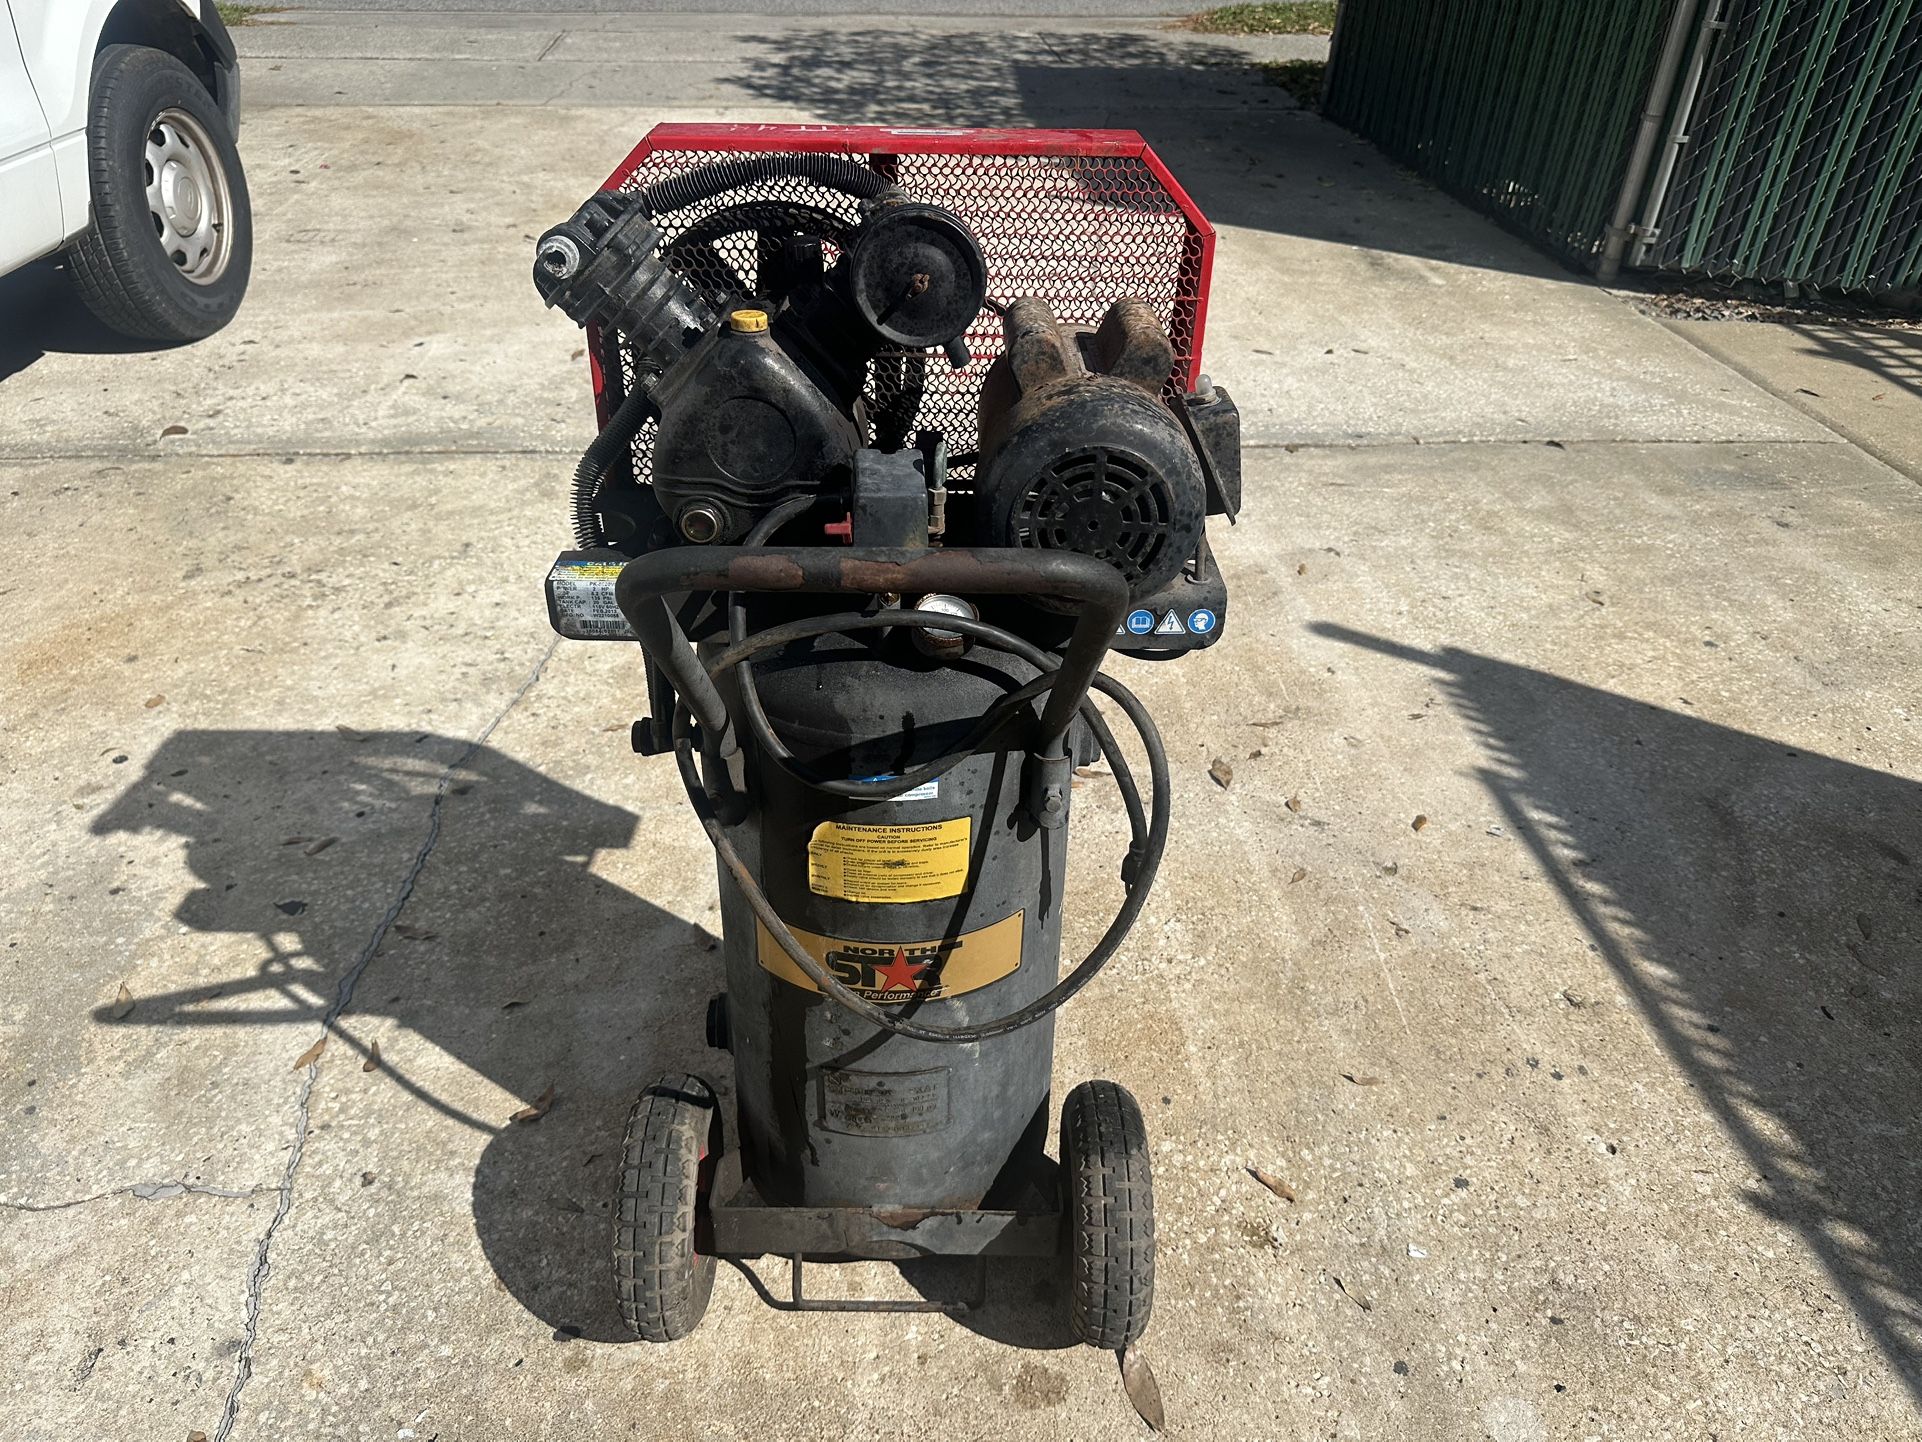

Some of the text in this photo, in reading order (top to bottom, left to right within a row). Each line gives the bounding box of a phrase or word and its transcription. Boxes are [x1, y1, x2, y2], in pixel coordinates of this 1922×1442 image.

[835, 824, 943, 834] MAINTENANCE INSTRUCTIONS
[843, 945, 937, 956] NORTH
